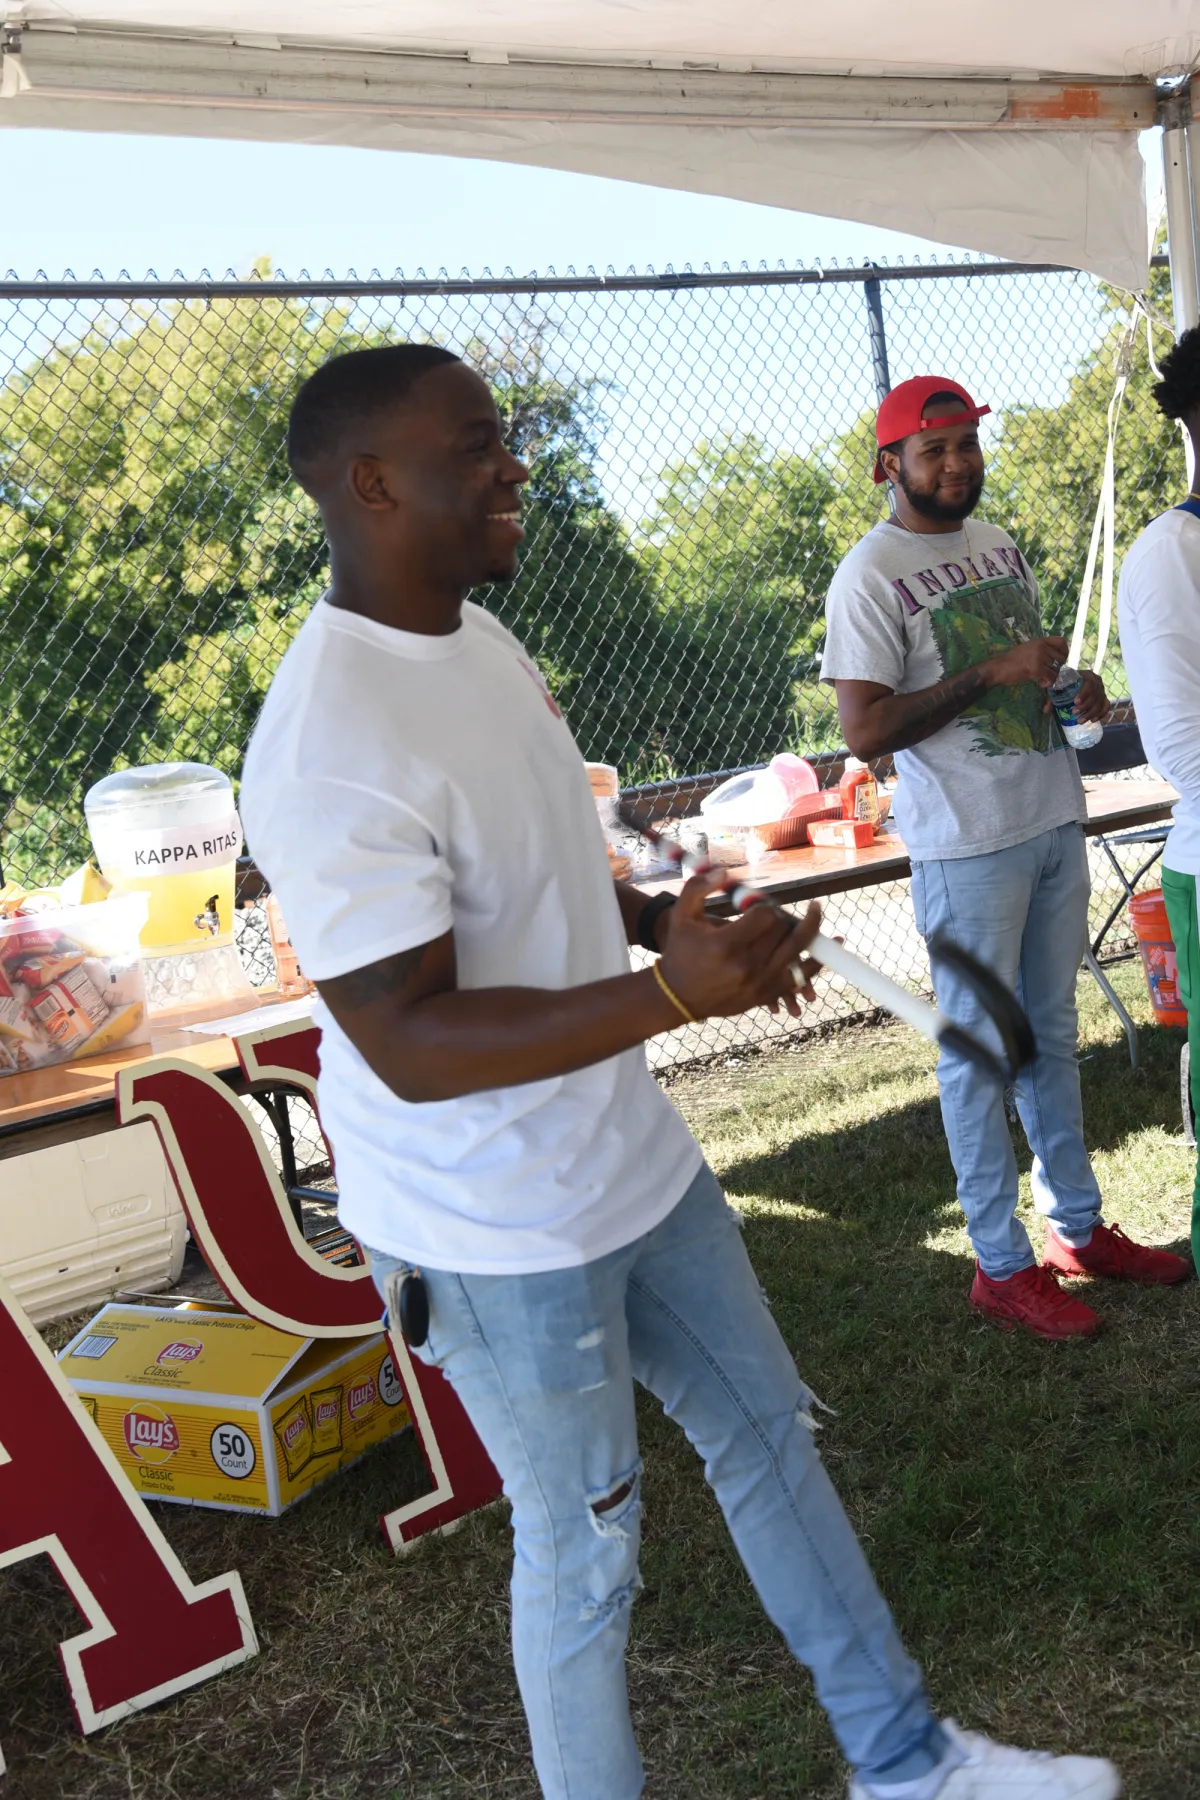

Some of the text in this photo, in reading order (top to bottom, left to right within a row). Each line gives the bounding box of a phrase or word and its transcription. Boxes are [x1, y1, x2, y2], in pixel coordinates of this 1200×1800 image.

[135, 831, 237, 865] KAPPA RITAS
[187, 1318, 211, 1327] Classic
[211, 1321, 236, 1329] Potato
[236, 1323, 256, 1331] Chips
[160, 1342, 201, 1360] Lay's
[143, 1365, 182, 1378] Classic
[350, 1380, 374, 1411] Lay's
[130, 1414, 174, 1447] Lay's
[219, 1433, 246, 1457] 50
[221, 1456, 248, 1470] Count
[139, 1466, 173, 1481] Classic
[141, 1480, 175, 1491] Potato Chips
